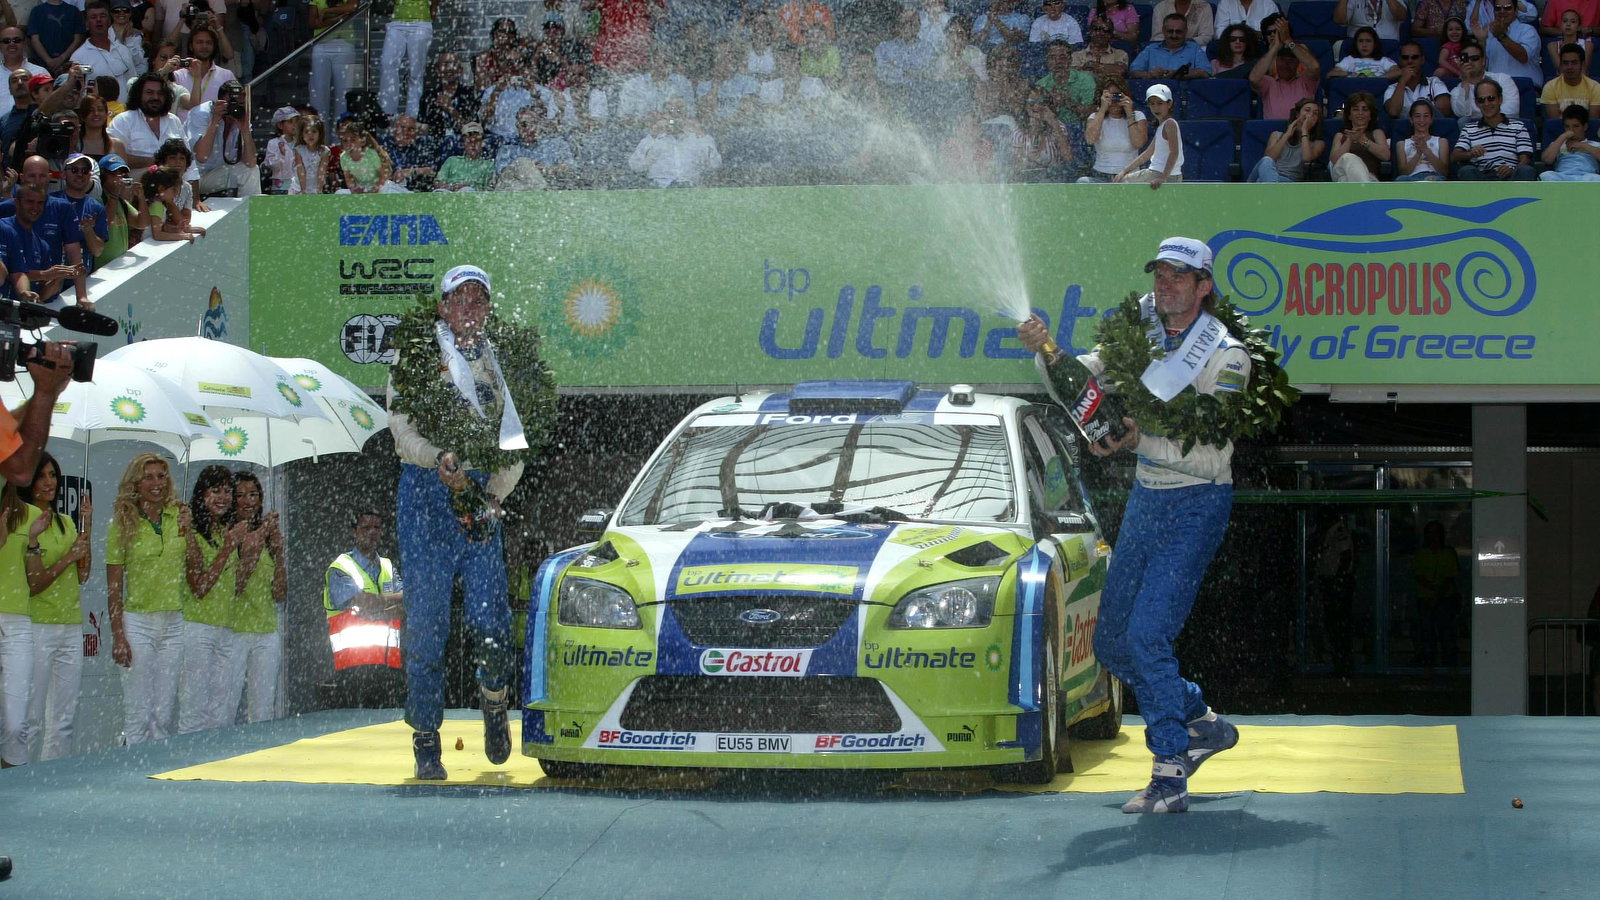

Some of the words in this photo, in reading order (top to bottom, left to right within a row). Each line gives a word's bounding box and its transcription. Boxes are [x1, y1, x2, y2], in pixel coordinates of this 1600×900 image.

[339, 258, 435, 280] WRC
[763, 259, 812, 301] bp
[1283, 262, 1452, 316] ACROPOLIS
[1182, 329, 1216, 370] RALLY
[1308, 325, 1360, 360] of
[1364, 325, 1537, 360] Greece
[126, 387, 142, 396] bp
[761, 413, 857, 425] Ford
[748, 611, 771, 621] Ford
[864, 640, 880, 652] bp
[563, 645, 653, 667] ultimate
[725, 651, 803, 673] Castrol
[864, 646, 976, 669] ultimate
[598, 730, 697, 746] BFGoodrich
[718, 737, 753, 750] EU55
[758, 738, 790, 750] BMV
[815, 733, 925, 749] BFGoodrich
[946, 732, 972, 743] PUMA
